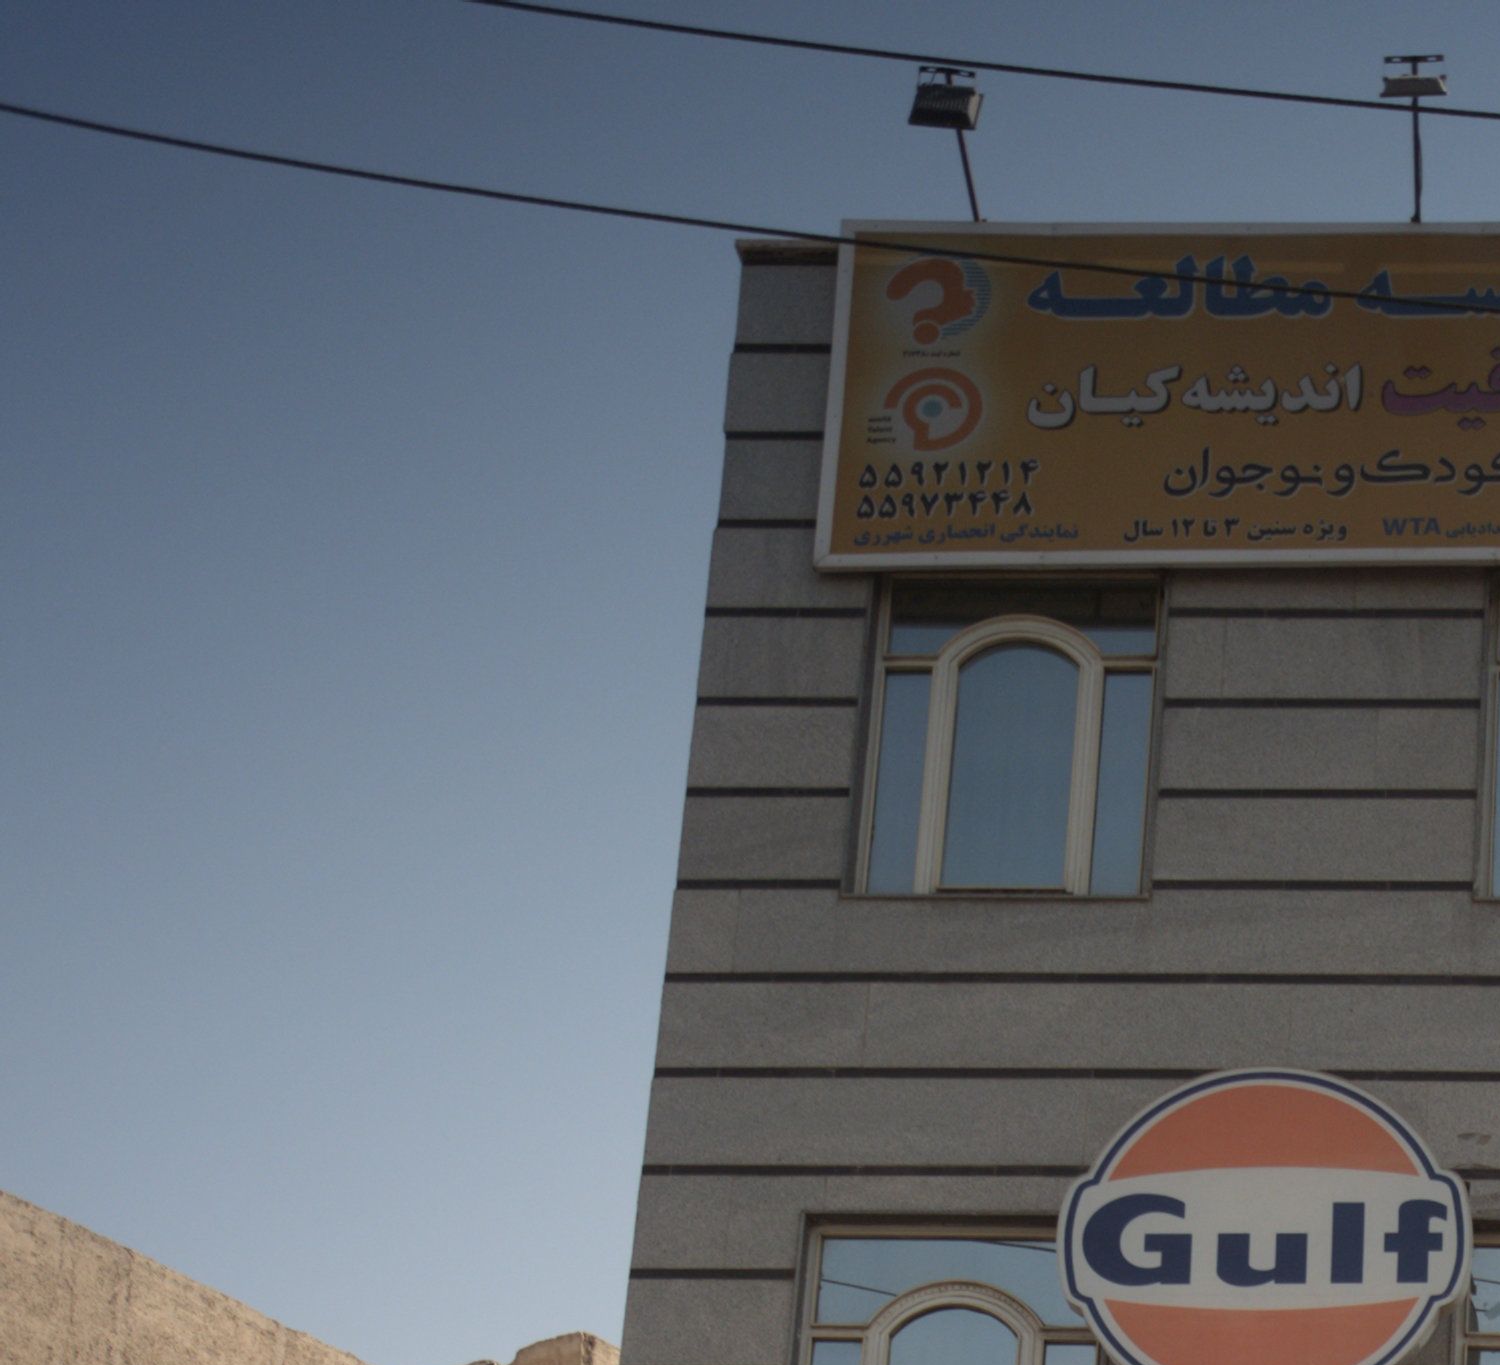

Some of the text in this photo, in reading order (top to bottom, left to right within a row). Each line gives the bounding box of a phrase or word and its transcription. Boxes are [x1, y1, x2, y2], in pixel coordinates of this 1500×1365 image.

[1027, 253, 1333, 318] مطالعه
[1026, 363, 1183, 430] کیان
[1182, 362, 1364, 427] اندیشه
[858, 458, 1040, 489] ۵۵۹۲۱۲۱۴
[1163, 446, 1323, 498] نوجوان
[1326, 462, 1356, 498] و
[856, 489, 1034, 520] ۵۵۹۷۳۴۴۸
[999, 523, 1079, 544] نمایندگی
[1123, 517, 1349, 543] ویژه سنین ۳ تا ۱۲ سال
[1382, 517, 1441, 536] WTA
[1081, 1192, 1448, 1288] Gulf
